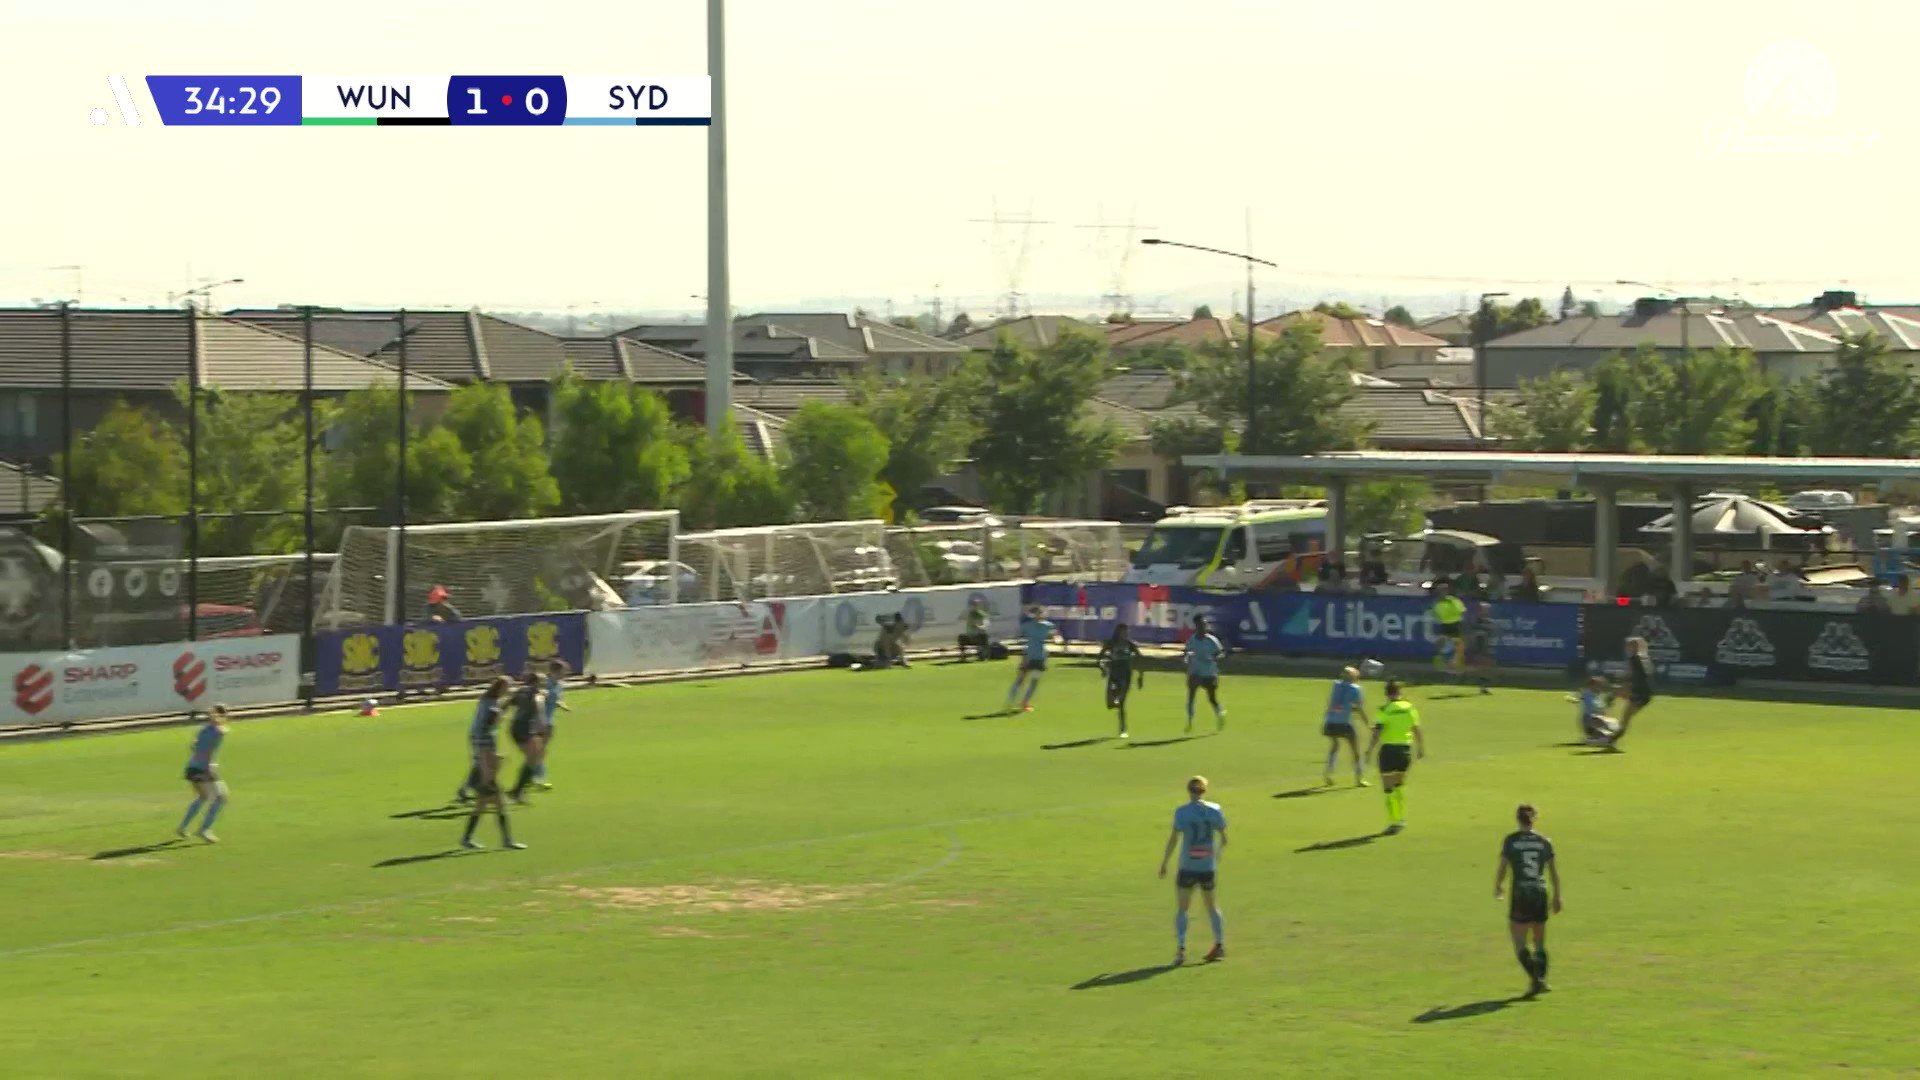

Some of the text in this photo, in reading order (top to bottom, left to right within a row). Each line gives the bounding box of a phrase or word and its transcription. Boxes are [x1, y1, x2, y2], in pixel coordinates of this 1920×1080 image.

[1325, 602, 1437, 642] Libert
[64, 663, 138, 684] SHARP
[214, 652, 282, 671] SHARP
[1522, 850, 1540, 878] 5
